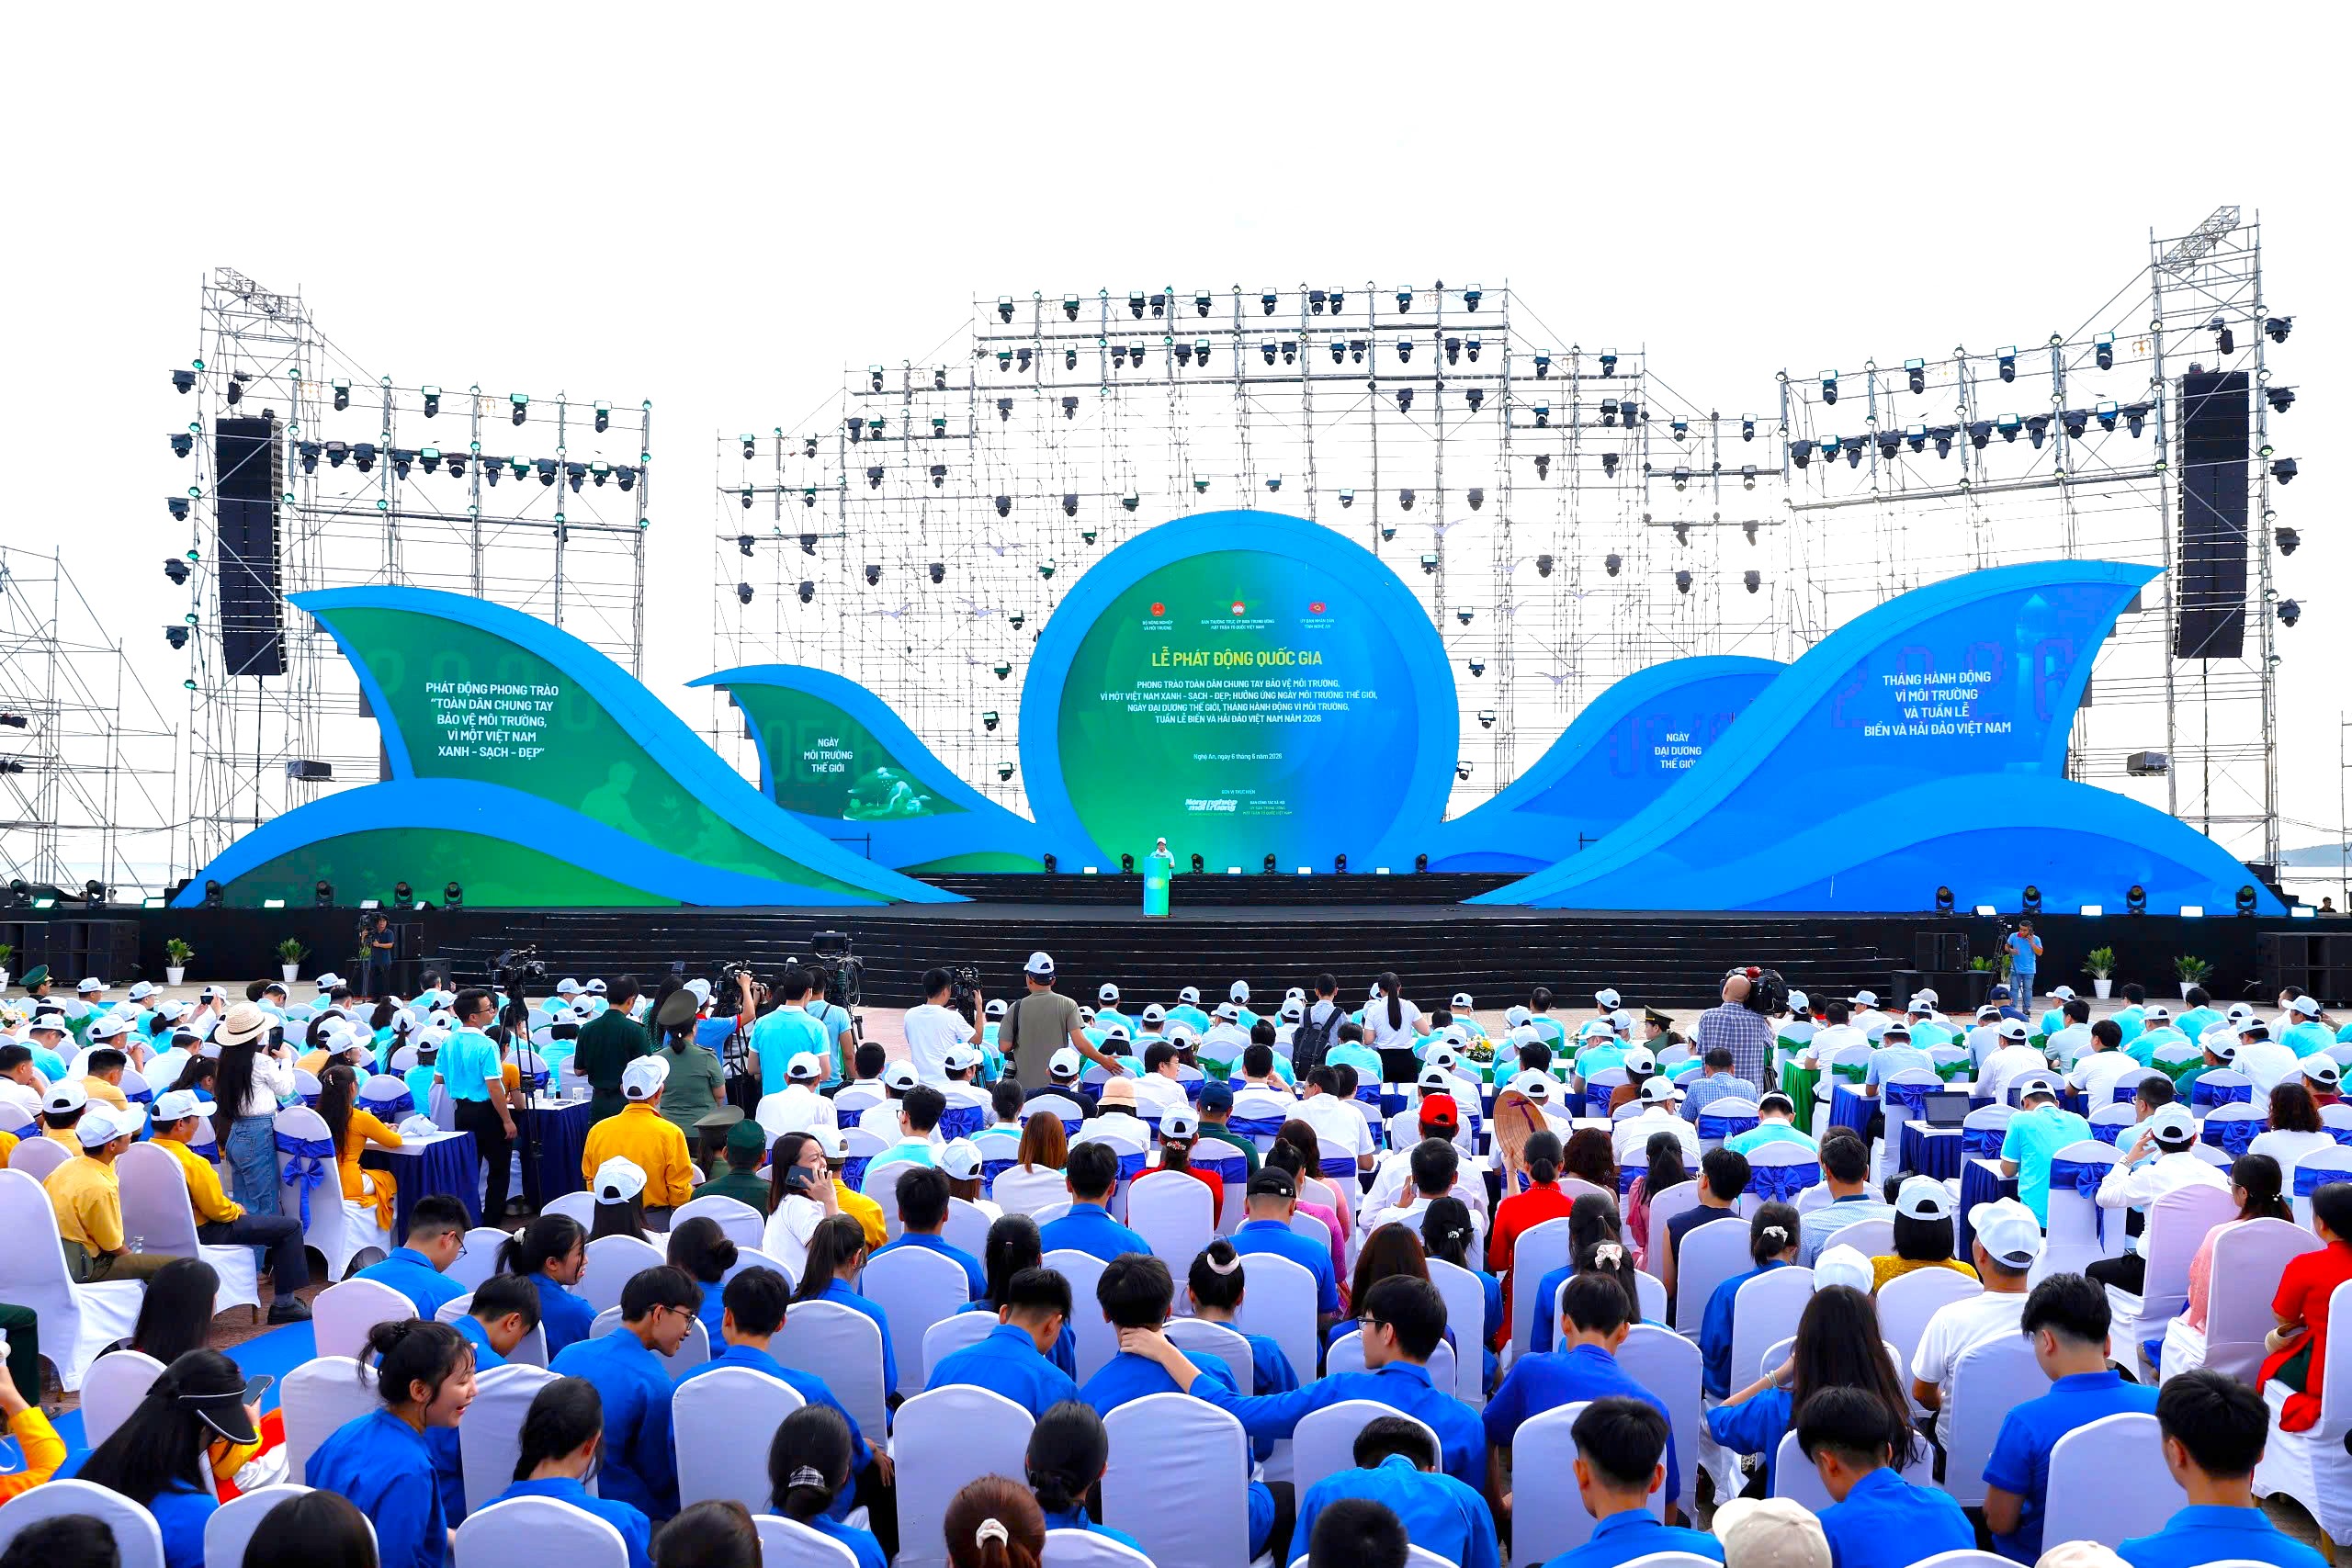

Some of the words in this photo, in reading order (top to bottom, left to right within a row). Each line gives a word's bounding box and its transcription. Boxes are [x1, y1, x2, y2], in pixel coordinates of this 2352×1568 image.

[1151, 646, 1170, 667] LỄ
[1173, 649, 1210, 666] PHÁT
[1214, 649, 1253, 670] ĐỘNG
[1257, 646, 1295, 667] QUỐC
[1298, 651, 1323, 665] GIA
[1164, 679, 1183, 688] TRÀO
[1185, 679, 1204, 688] TOÀN
[1206, 679, 1222, 688] DÂN
[1224, 680, 1249, 688] CHUNG
[1266, 678, 1281, 687] BẢO
[1282, 678, 1292, 690] VỆ
[1293, 678, 1306, 687] MÔI
[1883, 672, 1922, 686] THÁNG
[1924, 671, 1956, 685] HÀNH
[1959, 670, 1991, 685] ĐỘNG
[425, 680, 455, 694] PHÁT
[458, 681, 488, 696] ĐỘNG
[490, 684, 527, 695] PHONG
[529, 683, 559, 696] TRÀO
[1108, 691, 1124, 702] MỘT
[1125, 691, 1142, 702] VIỆT
[1188, 693, 1207, 701] SẠCH
[1277, 690, 1296, 699] NGÀY
[1299, 690, 1311, 699] MÔI
[1345, 689, 1361, 698] THẾ
[1895, 689, 1905, 703] VÌ
[1908, 689, 1928, 702] MÔI
[1931, 687, 1978, 700] TRƯỜNG
[469, 697, 492, 710] DÂN
[494, 700, 532, 711] CHUNG
[534, 701, 553, 711] TAY
[1127, 703, 1147, 712] NGÀY
[1148, 705, 1160, 713] ĐẠI
[1162, 704, 1188, 712] DƯƠNG
[1189, 702, 1204, 711] THẾ
[1223, 702, 1248, 711] THÁNG
[1250, 702, 1271, 711] HÀNH
[1272, 702, 1293, 713] ĐỘNG
[1294, 701, 1302, 711] VÌ
[1303, 701, 1316, 710] MÔI
[1904, 705, 1918, 718] VÀ
[1921, 703, 1952, 718] TUẦN
[1954, 702, 1970, 717] LỄ
[436, 712, 459, 725] BẢO
[462, 713, 476, 728] VỆ
[478, 713, 498, 726] MÔI
[500, 714, 548, 728] TRƯỜNG,
[1155, 712, 1175, 723] TUẦN
[1177, 712, 1186, 723] LỄ
[1188, 712, 1205, 723] BIỂN
[1206, 714, 1216, 723] VÀ
[1217, 713, 1230, 723] HẢI
[1231, 713, 1247, 723] ĐẢO
[1249, 713, 1265, 724] VIỆT
[1266, 715, 1283, 723] NAM
[1284, 713, 1301, 722] NĂM
[1864, 720, 1891, 737] BIỂN
[1893, 723, 1907, 736] VÀ
[1909, 721, 1928, 735] HẢI
[1930, 721, 1955, 735] ĐẢO
[1957, 720, 1982, 737] VIỆT
[1985, 722, 2011, 733] NAM
[447, 728, 458, 741] VÌ
[460, 728, 483, 743] MỘT
[485, 729, 510, 744] VIỆT
[512, 732, 537, 742] NAM
[818, 736, 839, 747] NGÀY
[1666, 731, 1690, 742] NGÀY
[438, 746, 469, 756] XANH
[479, 747, 508, 760] SẠCH
[804, 750, 818, 760] MÔI
[820, 750, 853, 760] TRƯỜNG
[1654, 747, 1669, 757] ĐẠI
[1671, 746, 1702, 755] DƯƠNG
[811, 761, 829, 772] THẾ
[829, 761, 844, 772] GIỚI
[1660, 757, 1679, 769] THẾ
